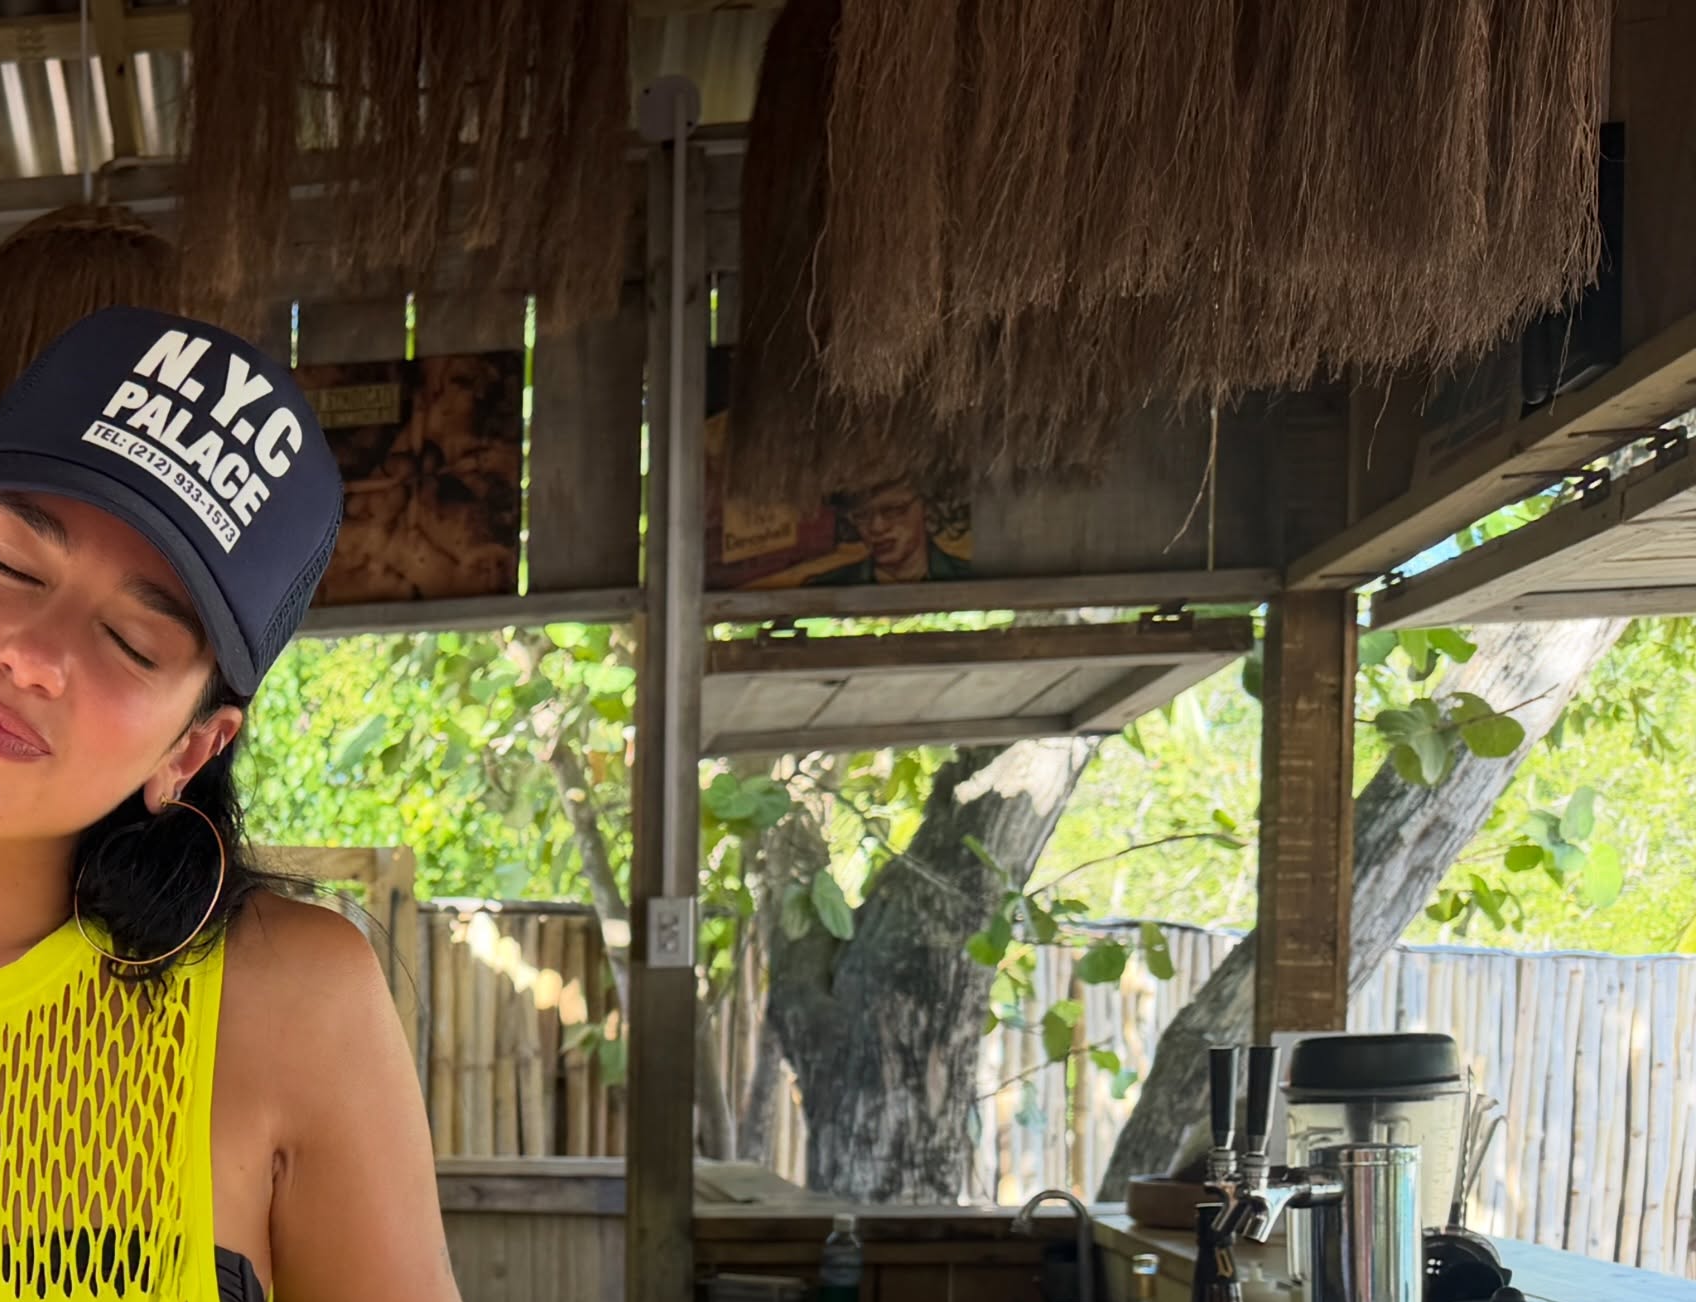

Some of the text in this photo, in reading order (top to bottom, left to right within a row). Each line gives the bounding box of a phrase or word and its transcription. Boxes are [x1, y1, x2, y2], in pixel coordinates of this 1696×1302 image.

[92, 423, 237, 544] TEL: (212) 933-1573
[102, 379, 271, 527] PALACE
